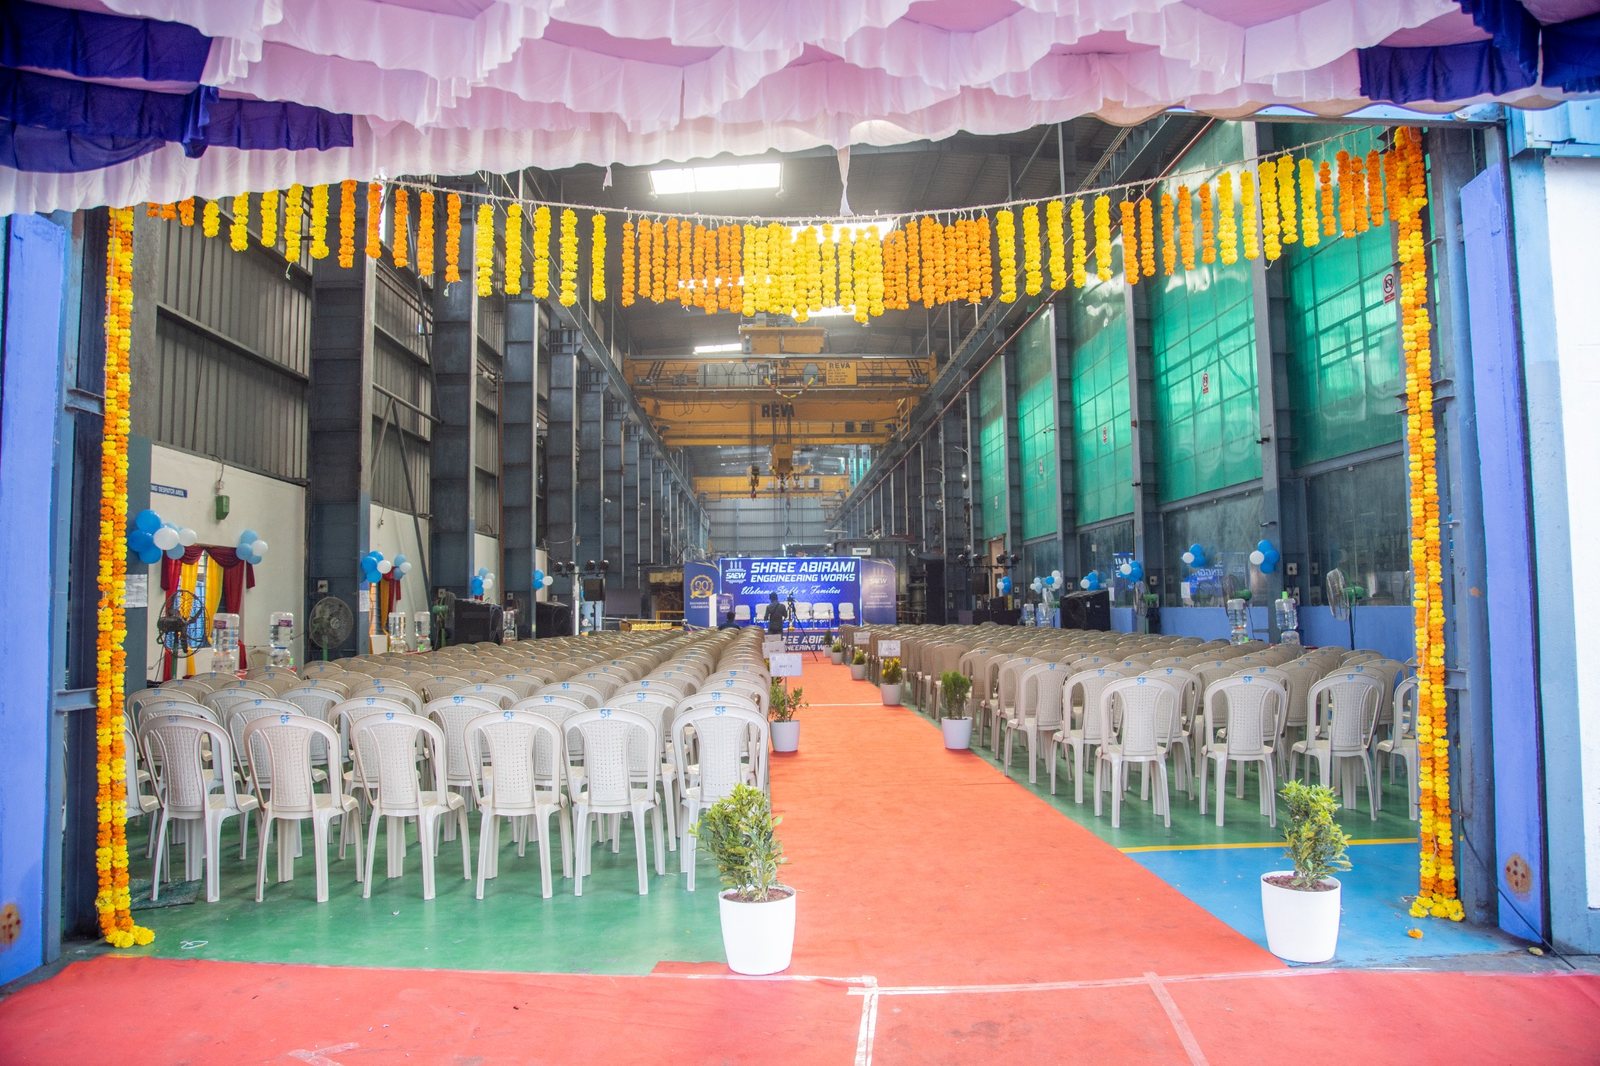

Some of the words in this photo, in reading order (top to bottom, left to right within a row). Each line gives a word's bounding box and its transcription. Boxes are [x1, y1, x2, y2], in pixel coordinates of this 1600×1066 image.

[750, 562, 796, 573] SHREE
[800, 561, 856, 573] ABIRAMI
[750, 574, 818, 583] ENGGINEERING
[820, 573, 856, 582] WORKS
[695, 580, 709, 591] 90
[811, 584, 841, 595] Families
[1136, 676, 1147, 685] SF
[1242, 674, 1254, 684] SF
[560, 681, 570, 691] SF
[365, 697, 376, 706] SF
[452, 694, 464, 704] SF
[543, 695, 554, 703] SF
[636, 692, 647, 702] SF
[599, 708, 612, 718] SF
[714, 705, 727, 716] SF
[279, 714, 290, 725] SF
[385, 711, 395, 721] SF
[503, 711, 514, 721] SF
